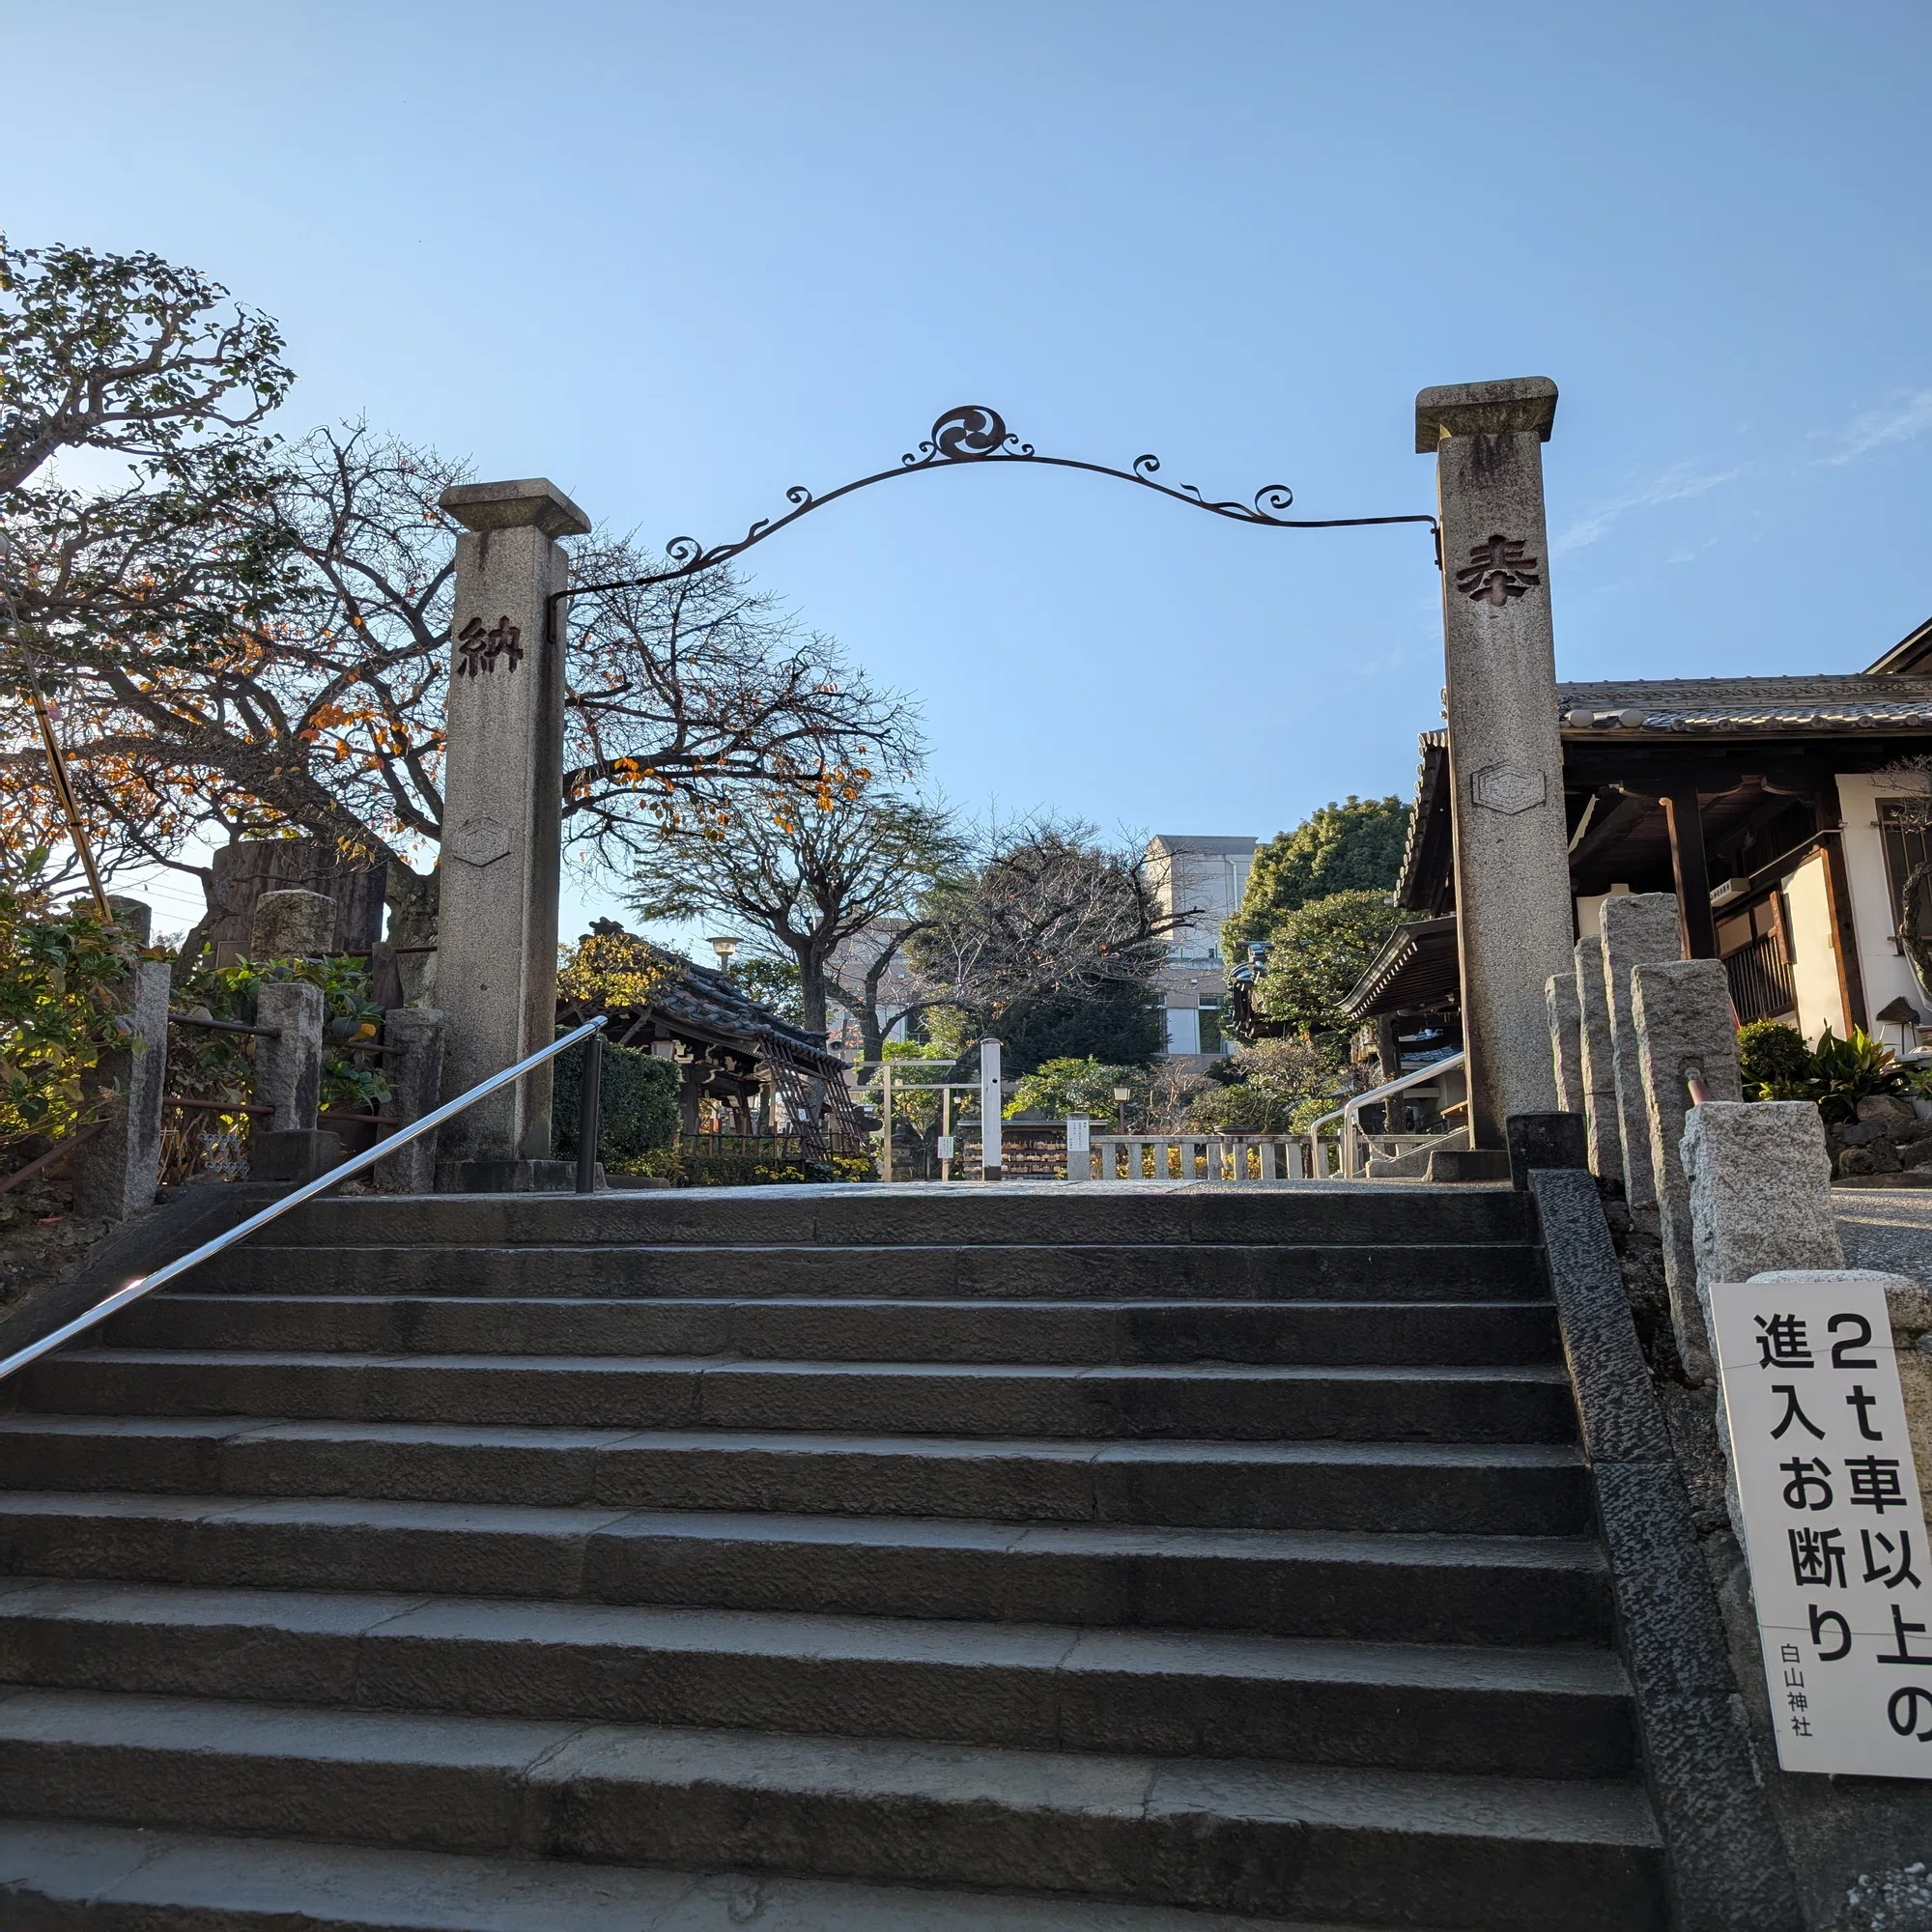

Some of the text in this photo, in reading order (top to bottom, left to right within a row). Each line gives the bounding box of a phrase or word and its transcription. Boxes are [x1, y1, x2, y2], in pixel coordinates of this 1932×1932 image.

[1456, 534, 1541, 607] 奉
[456, 615, 524, 678] 納
[1753, 1313, 1852, 1662] 進入お断り
[1827, 1313, 1932, 1743] 2t車以上の
[1780, 1643, 1812, 1737] 白山神社
